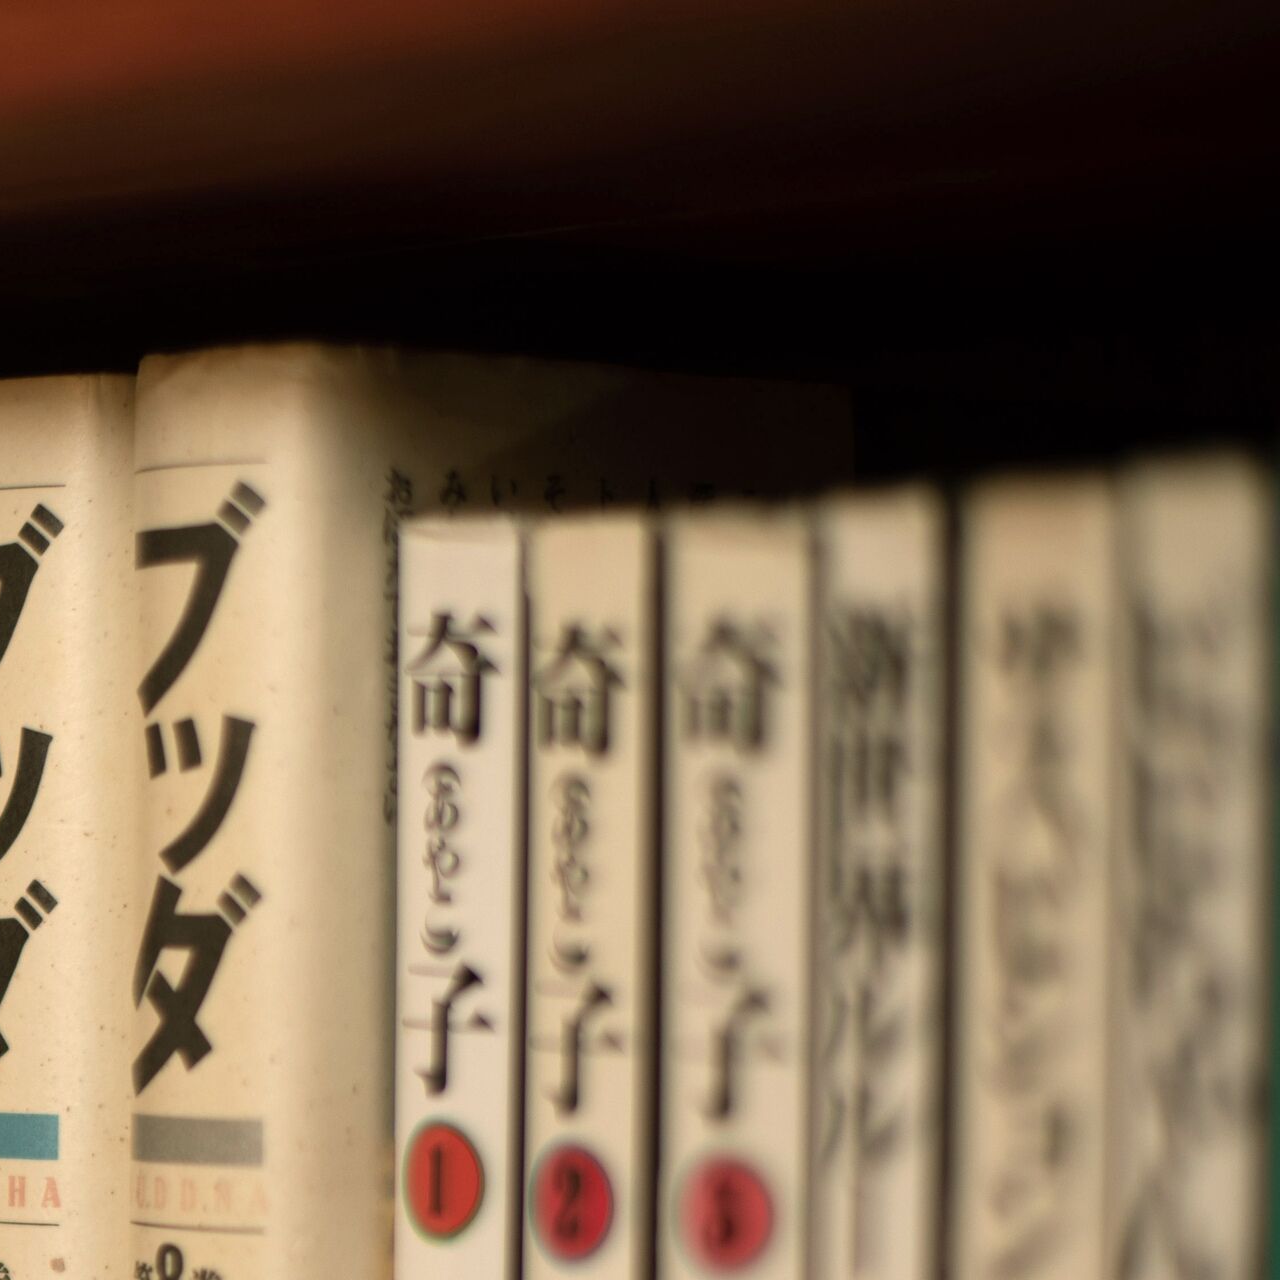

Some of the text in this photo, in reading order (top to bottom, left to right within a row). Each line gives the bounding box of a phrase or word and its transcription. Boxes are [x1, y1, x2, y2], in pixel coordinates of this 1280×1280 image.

[135, 481, 266, 1096] ブッダ
[553, 1163, 583, 1243] 2
